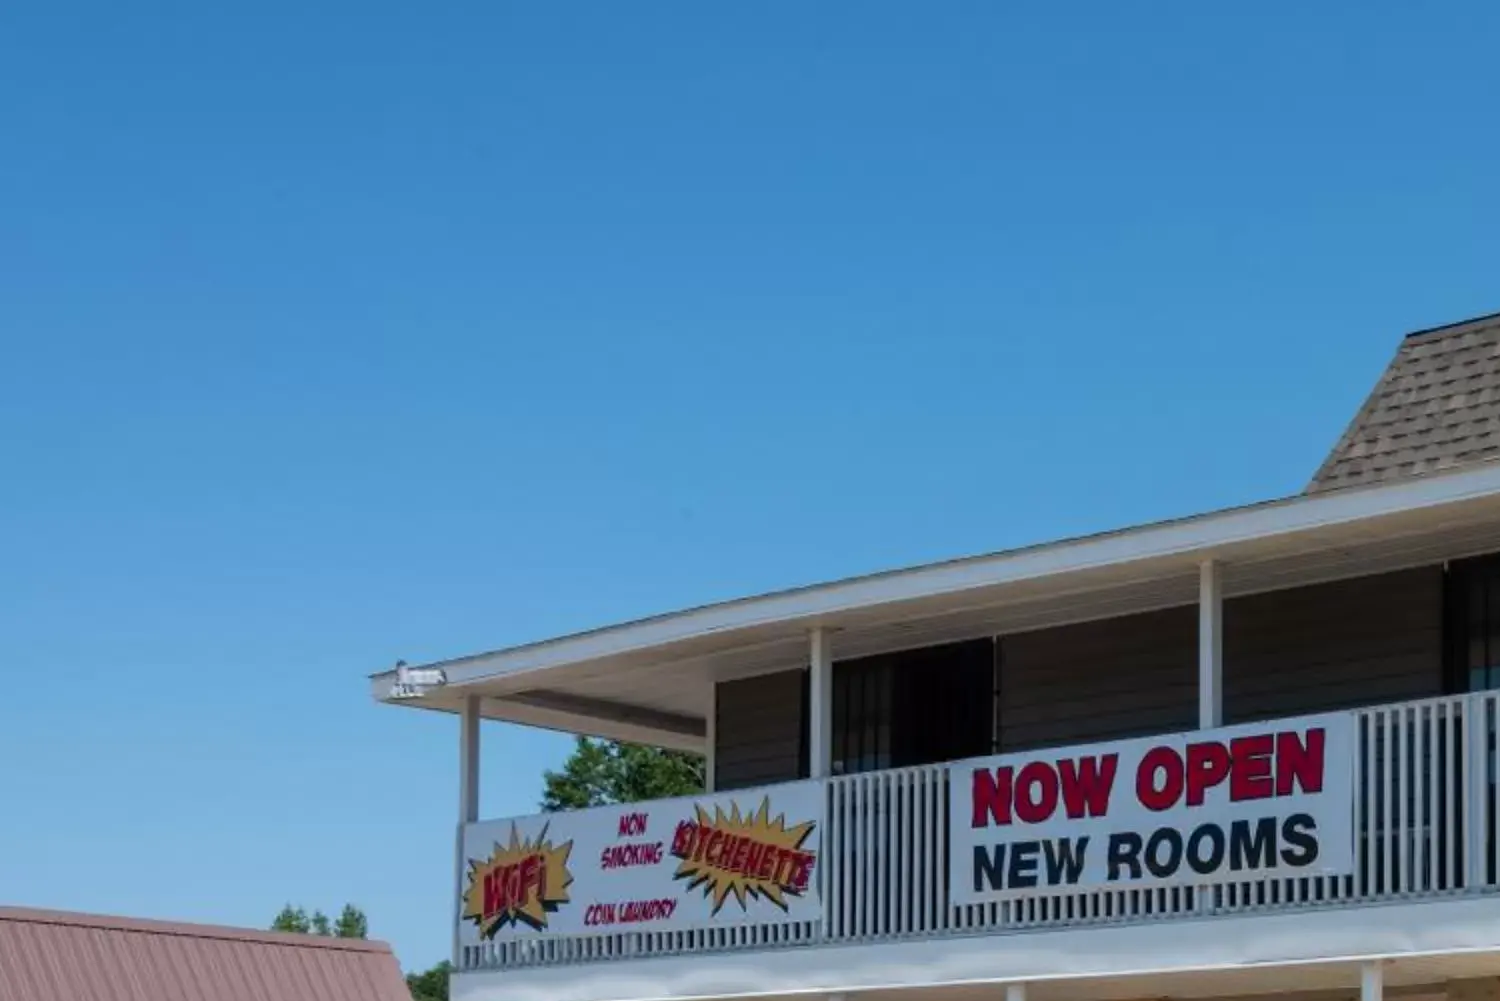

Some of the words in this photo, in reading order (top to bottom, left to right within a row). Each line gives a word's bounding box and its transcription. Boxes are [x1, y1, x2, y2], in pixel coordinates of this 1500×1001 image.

[971, 752, 1119, 828] NOW
[1136, 728, 1326, 812] OPEN
[618, 812, 649, 837] NON
[600, 841, 664, 870] SMOKING
[973, 835, 1091, 893] NEW
[1107, 812, 1319, 881] ROOMS
[584, 903, 617, 926] COIN
[618, 897, 678, 923] LAUNDRY
